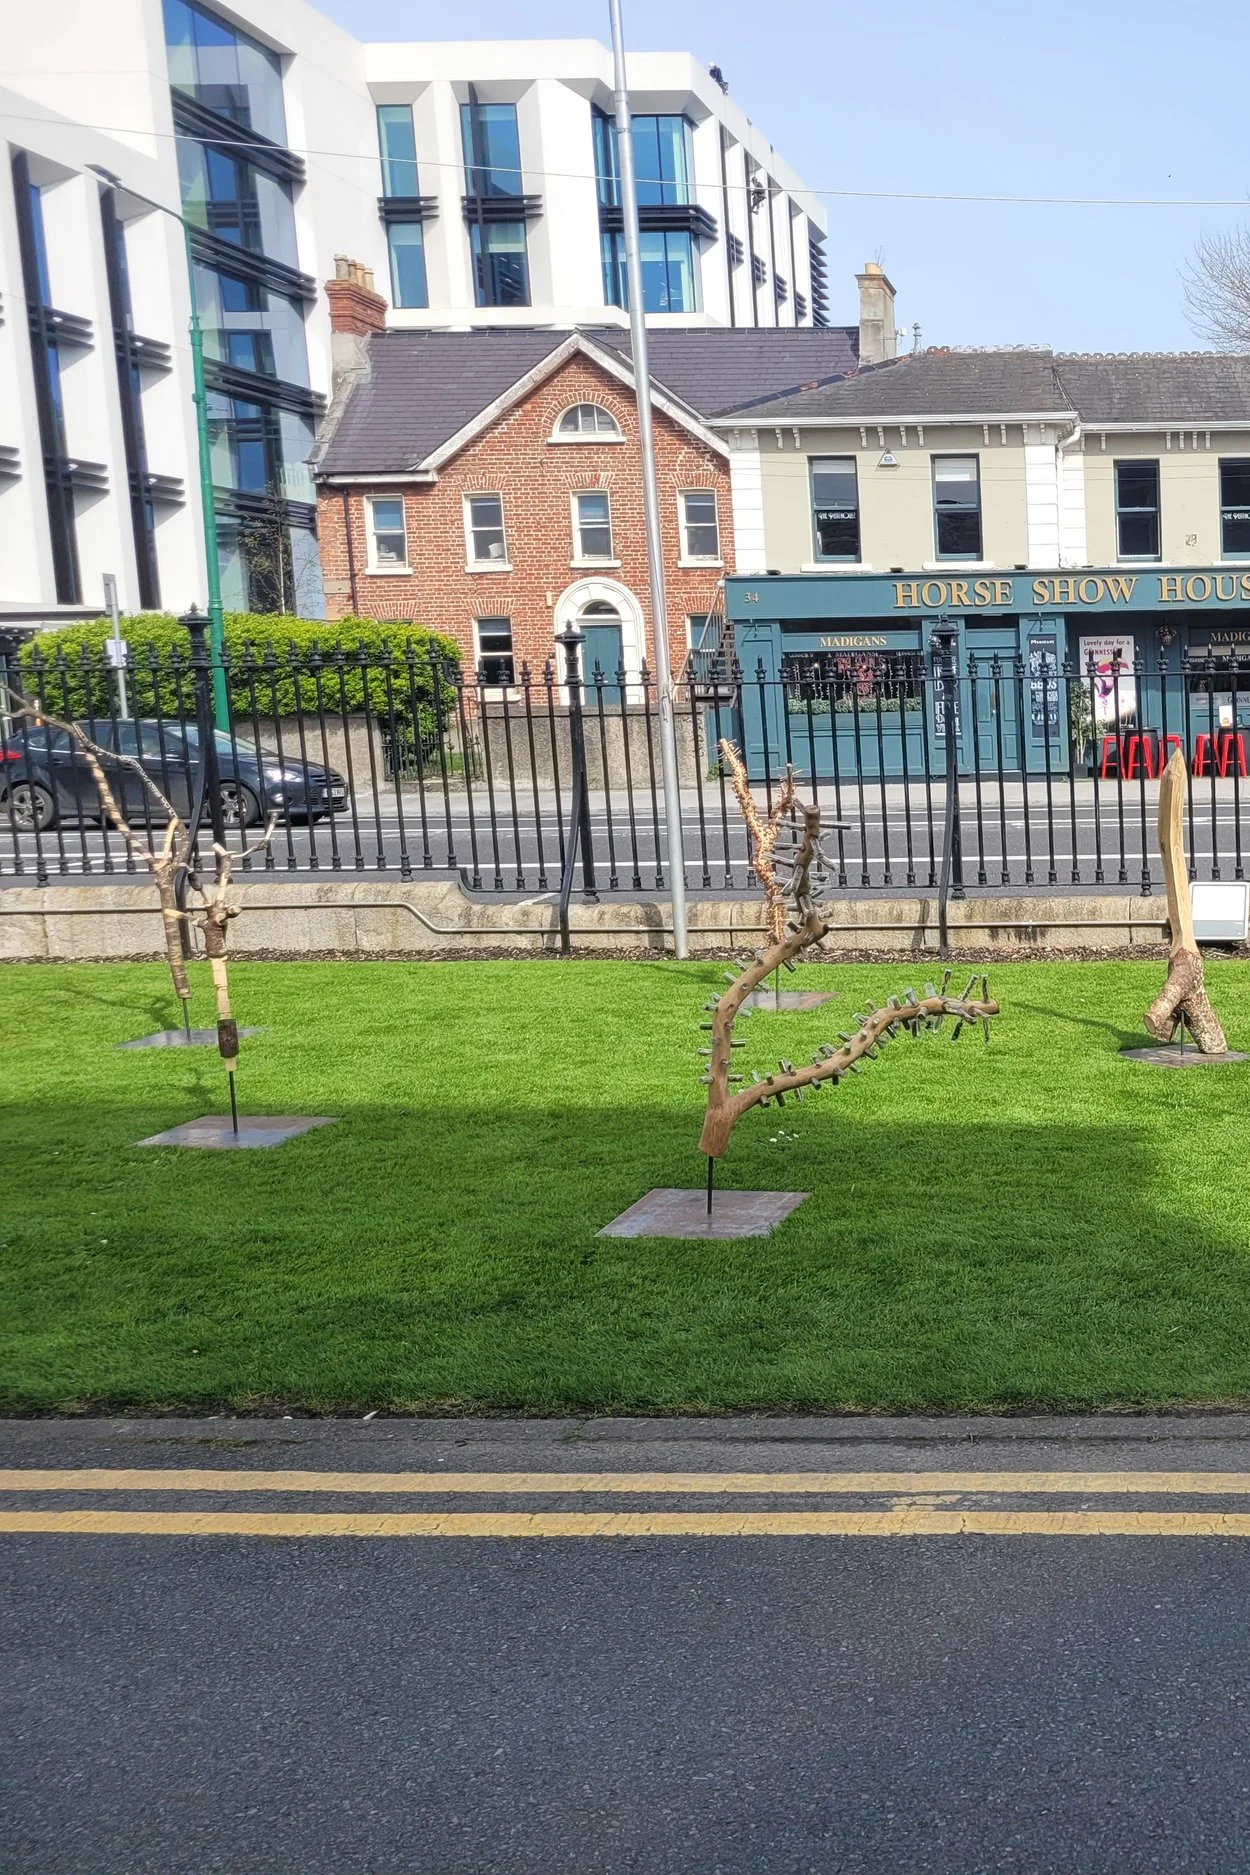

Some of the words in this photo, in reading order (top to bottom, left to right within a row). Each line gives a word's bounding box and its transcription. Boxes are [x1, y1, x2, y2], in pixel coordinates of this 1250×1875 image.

[744, 592, 759, 604] 34
[893, 579, 1014, 608] HORSE
[1033, 577, 1138, 605] SHOW
[820, 636, 887, 647] MADIGANS
[1084, 639, 1104, 647] Lovely
[1104, 639, 1115, 647] day
[1084, 648, 1114, 656] GINNESS
